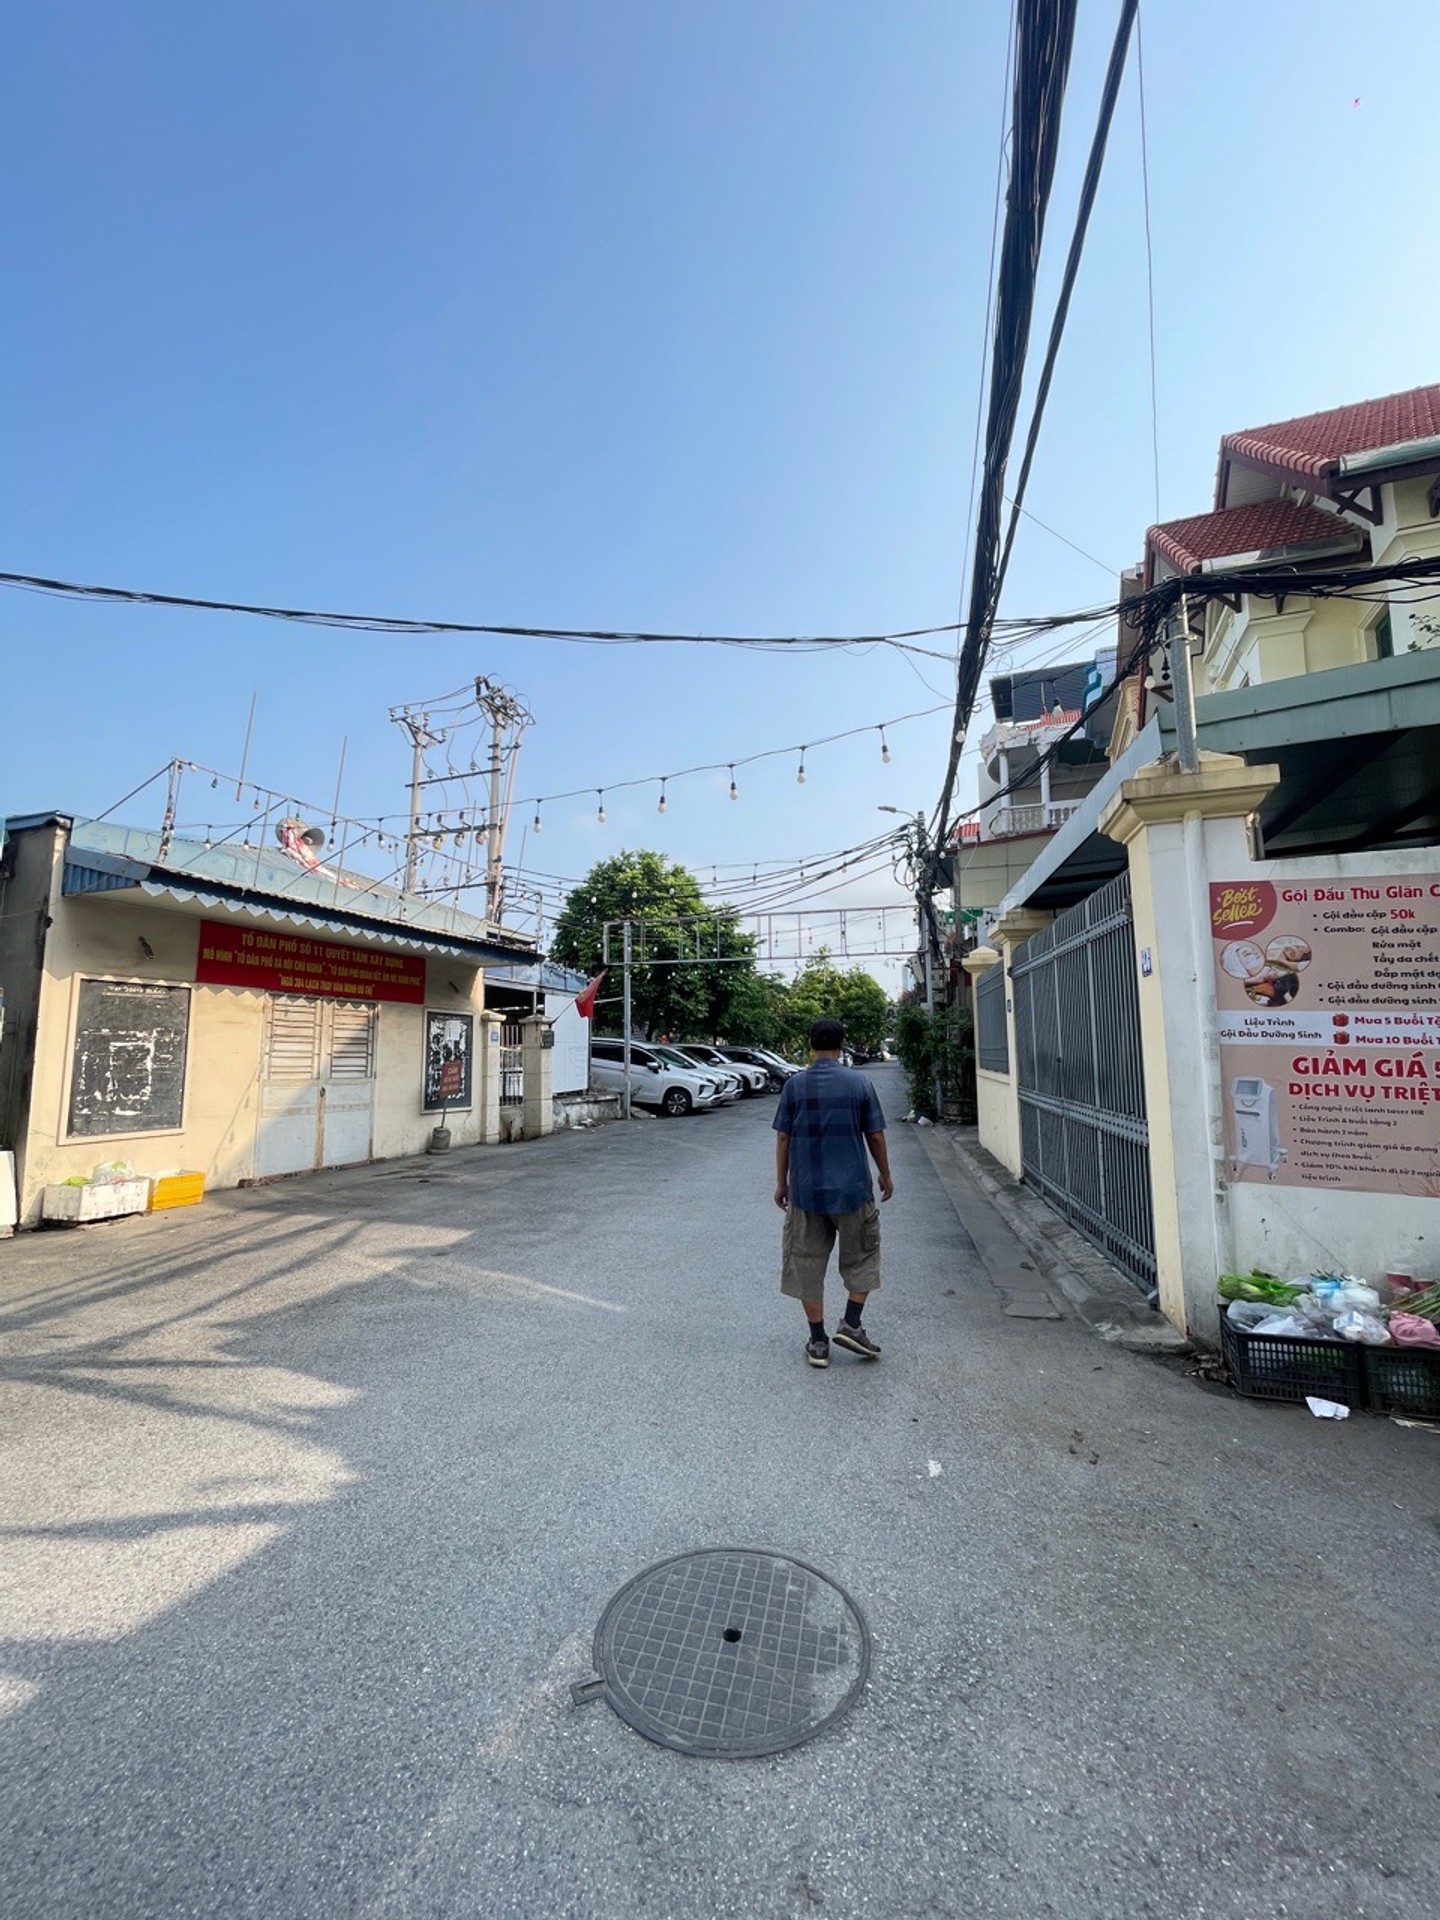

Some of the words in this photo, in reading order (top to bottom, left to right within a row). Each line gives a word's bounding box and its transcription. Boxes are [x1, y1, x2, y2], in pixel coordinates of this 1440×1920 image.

[1221, 886, 1259, 907] Best
[1350, 887, 1380, 900] Thu
[1390, 909, 1416, 919] 50k
[1324, 925, 1365, 933] Combo:
[1410, 981, 1436, 989] sinh
[1411, 996, 1437, 1004] sinh
[1267, 1017, 1295, 1026] Trình
[1354, 1016, 1382, 1025] Mua
[1394, 1012, 1424, 1025] Buổi
[1297, 1030, 1322, 1039] Sinh
[1355, 1035, 1383, 1044] Mua
[1386, 1036, 1401, 1044] 10
[1403, 1032, 1434, 1045] Buổi
[1292, 1049, 1367, 1077] GIẢM
[1374, 1051, 1428, 1078] GIÁ
[1288, 1083, 1340, 1100] DỊCH
[1344, 1085, 1376, 1103] VỤ
